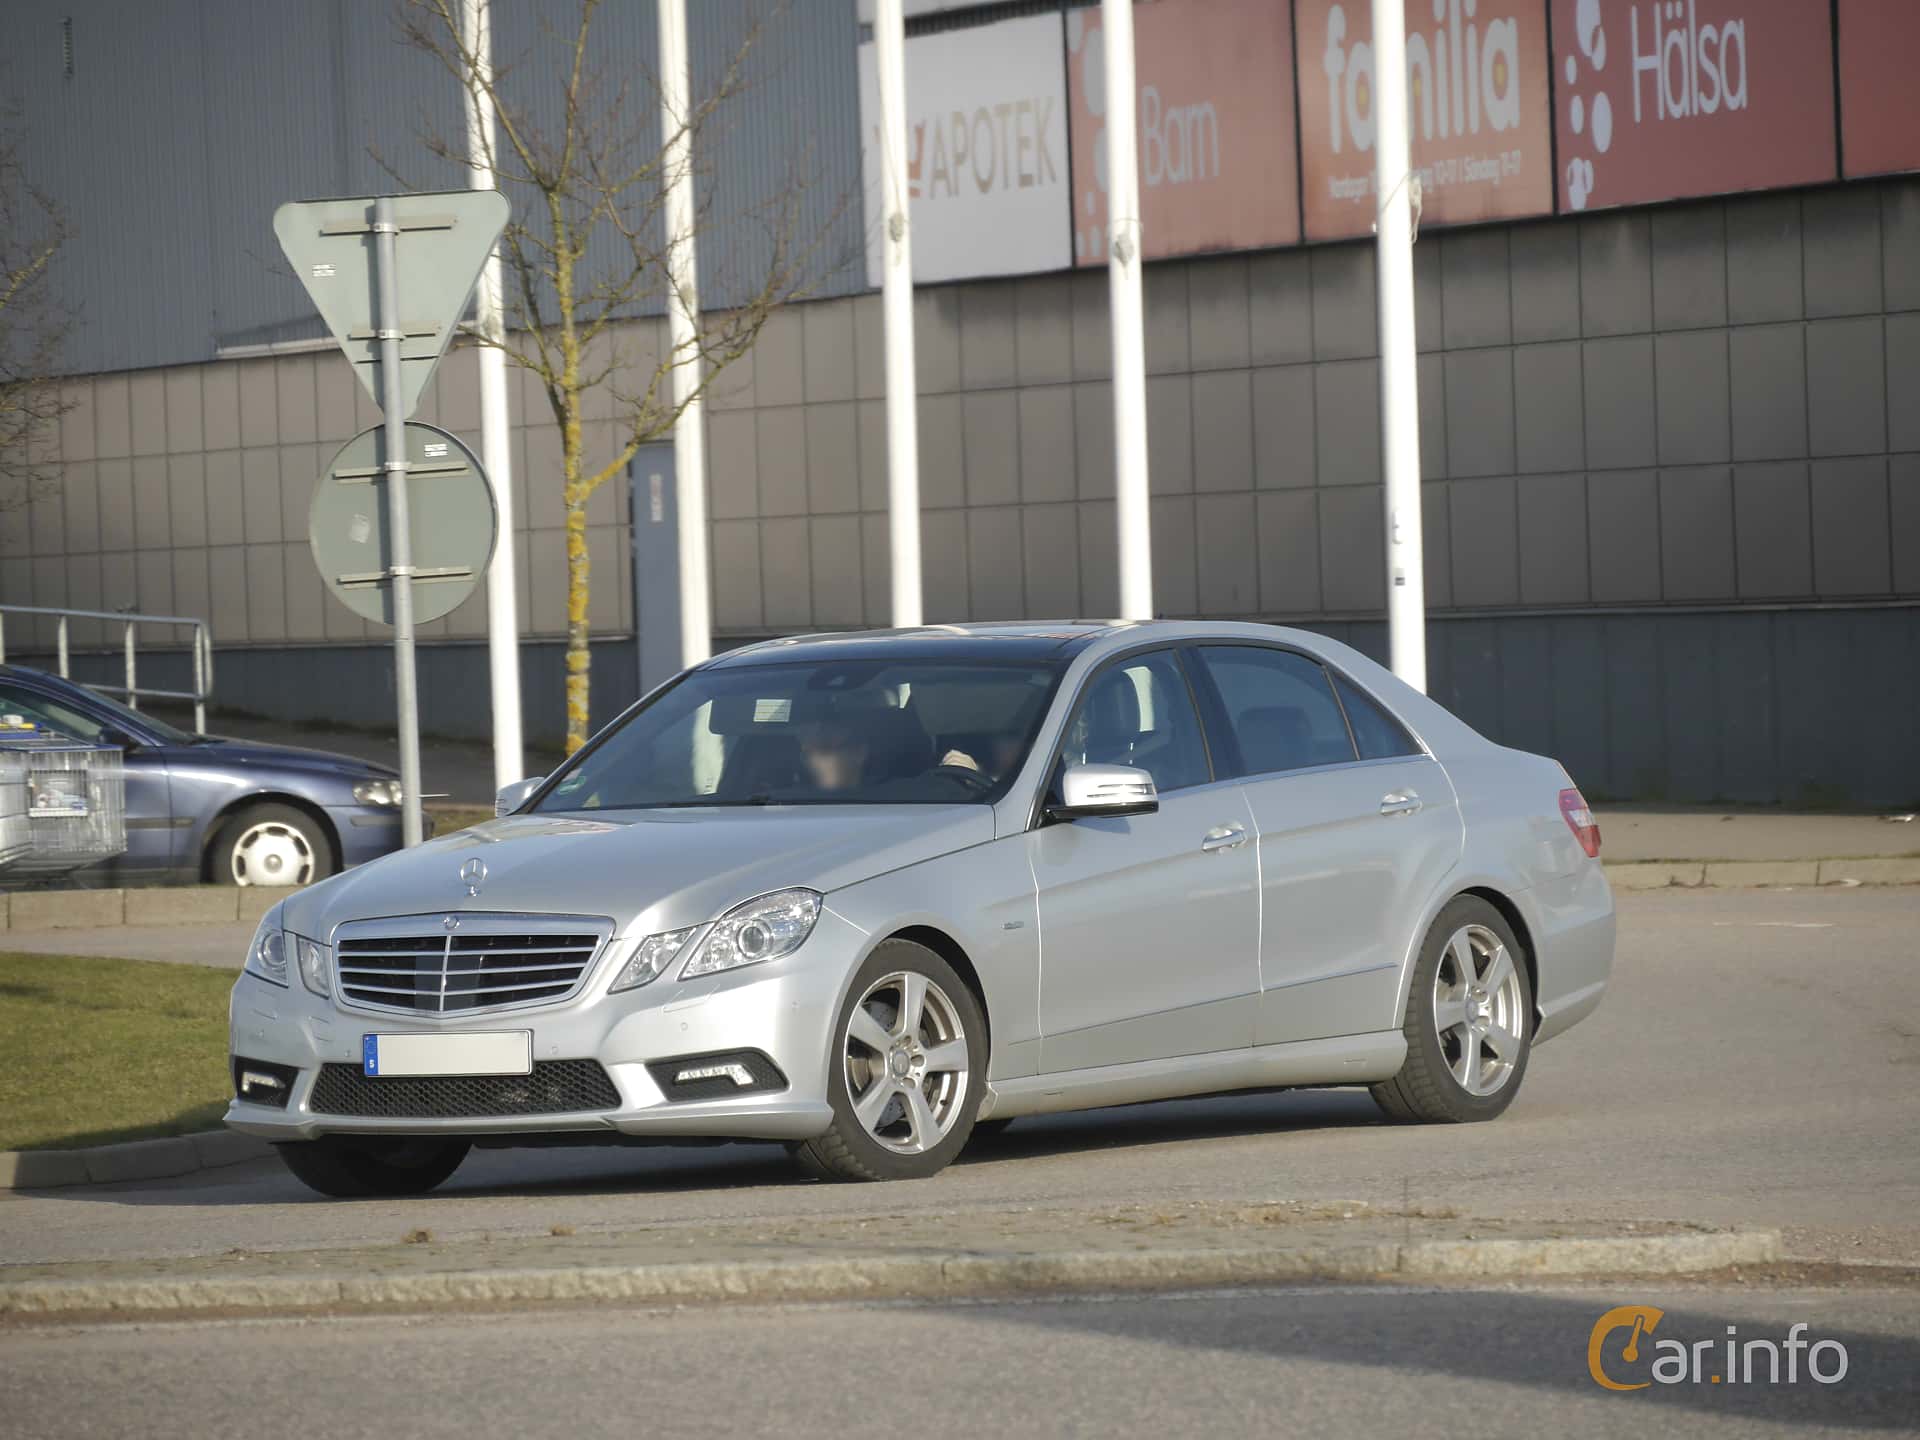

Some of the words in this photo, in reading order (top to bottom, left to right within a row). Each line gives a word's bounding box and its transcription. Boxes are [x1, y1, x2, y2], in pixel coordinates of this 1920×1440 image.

[1631, 0, 1747, 123] Hälsa
[931, 96, 1057, 200] APOTEK
[1141, 85, 1219, 186] Barn
